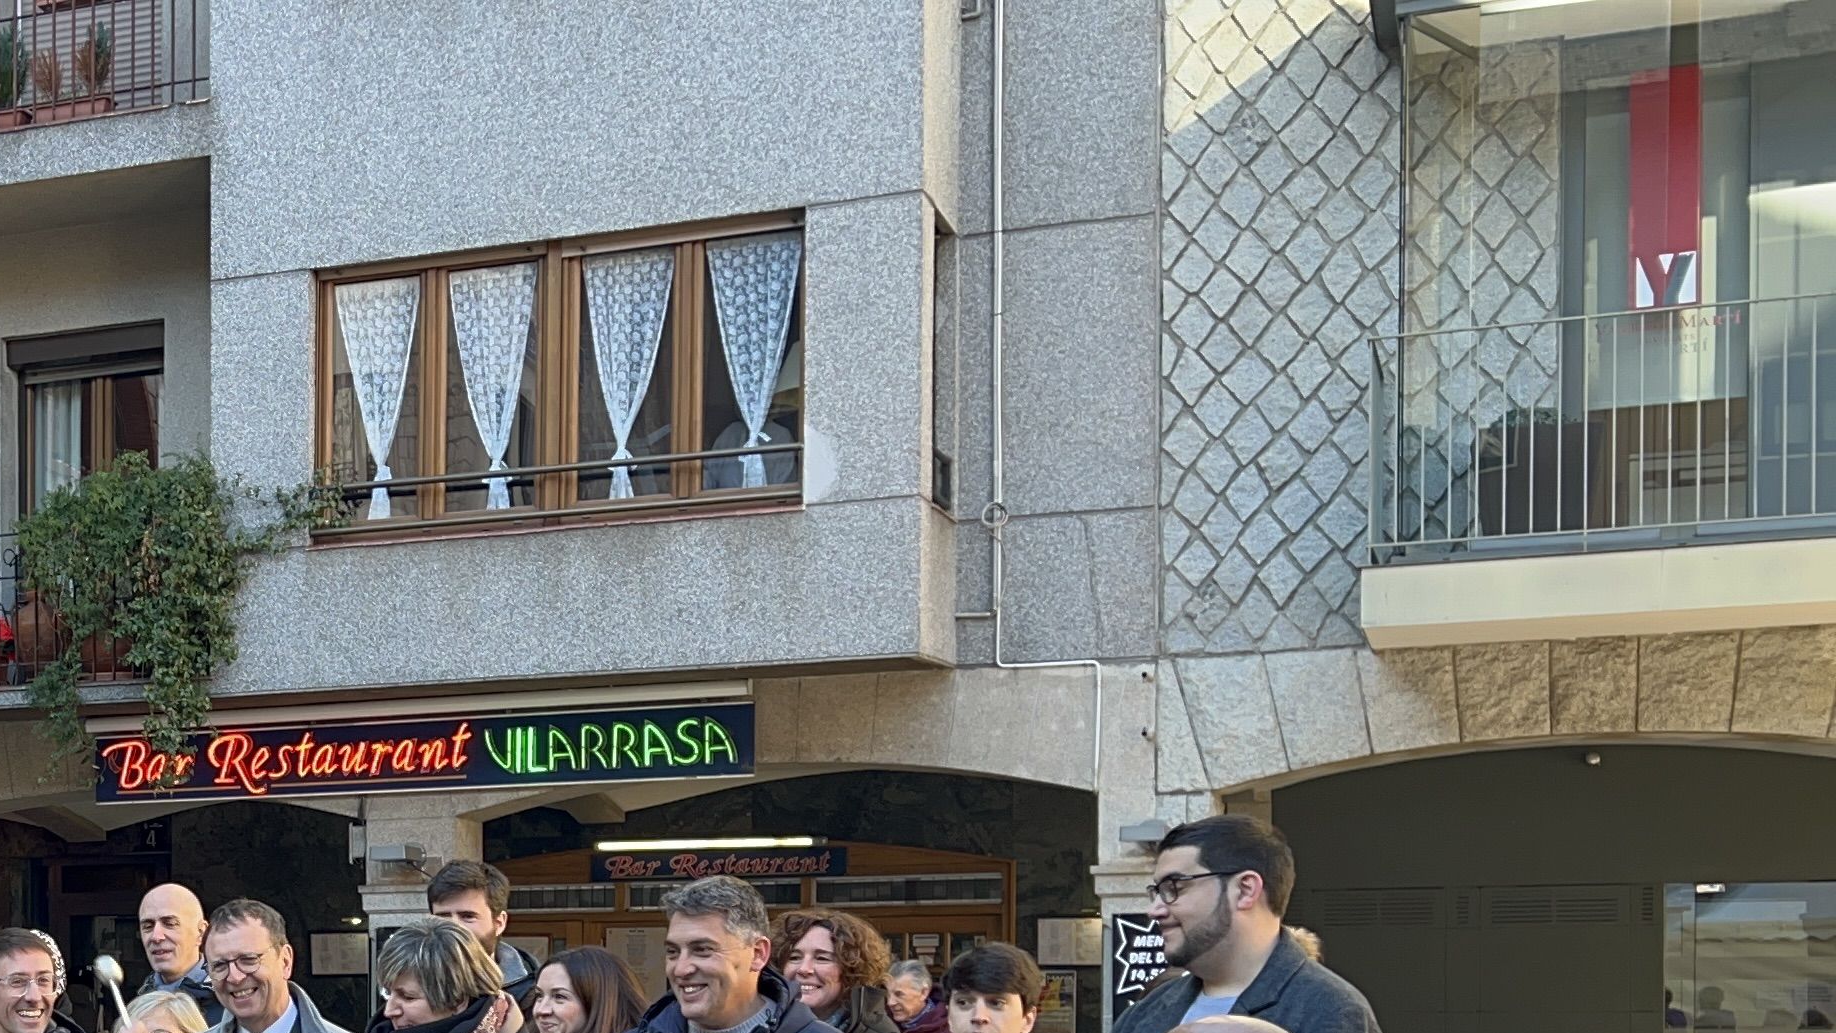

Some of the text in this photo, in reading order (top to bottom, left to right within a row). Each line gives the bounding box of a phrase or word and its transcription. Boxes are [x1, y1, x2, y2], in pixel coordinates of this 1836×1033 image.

[102, 716, 739, 794] Bar Restaurant VILARRASA
[146, 829, 157, 848] 4
[605, 850, 831, 880] Bar Restaurant
[1133, 935, 1165, 948] MEN
[1129, 951, 1168, 964] DEL D
